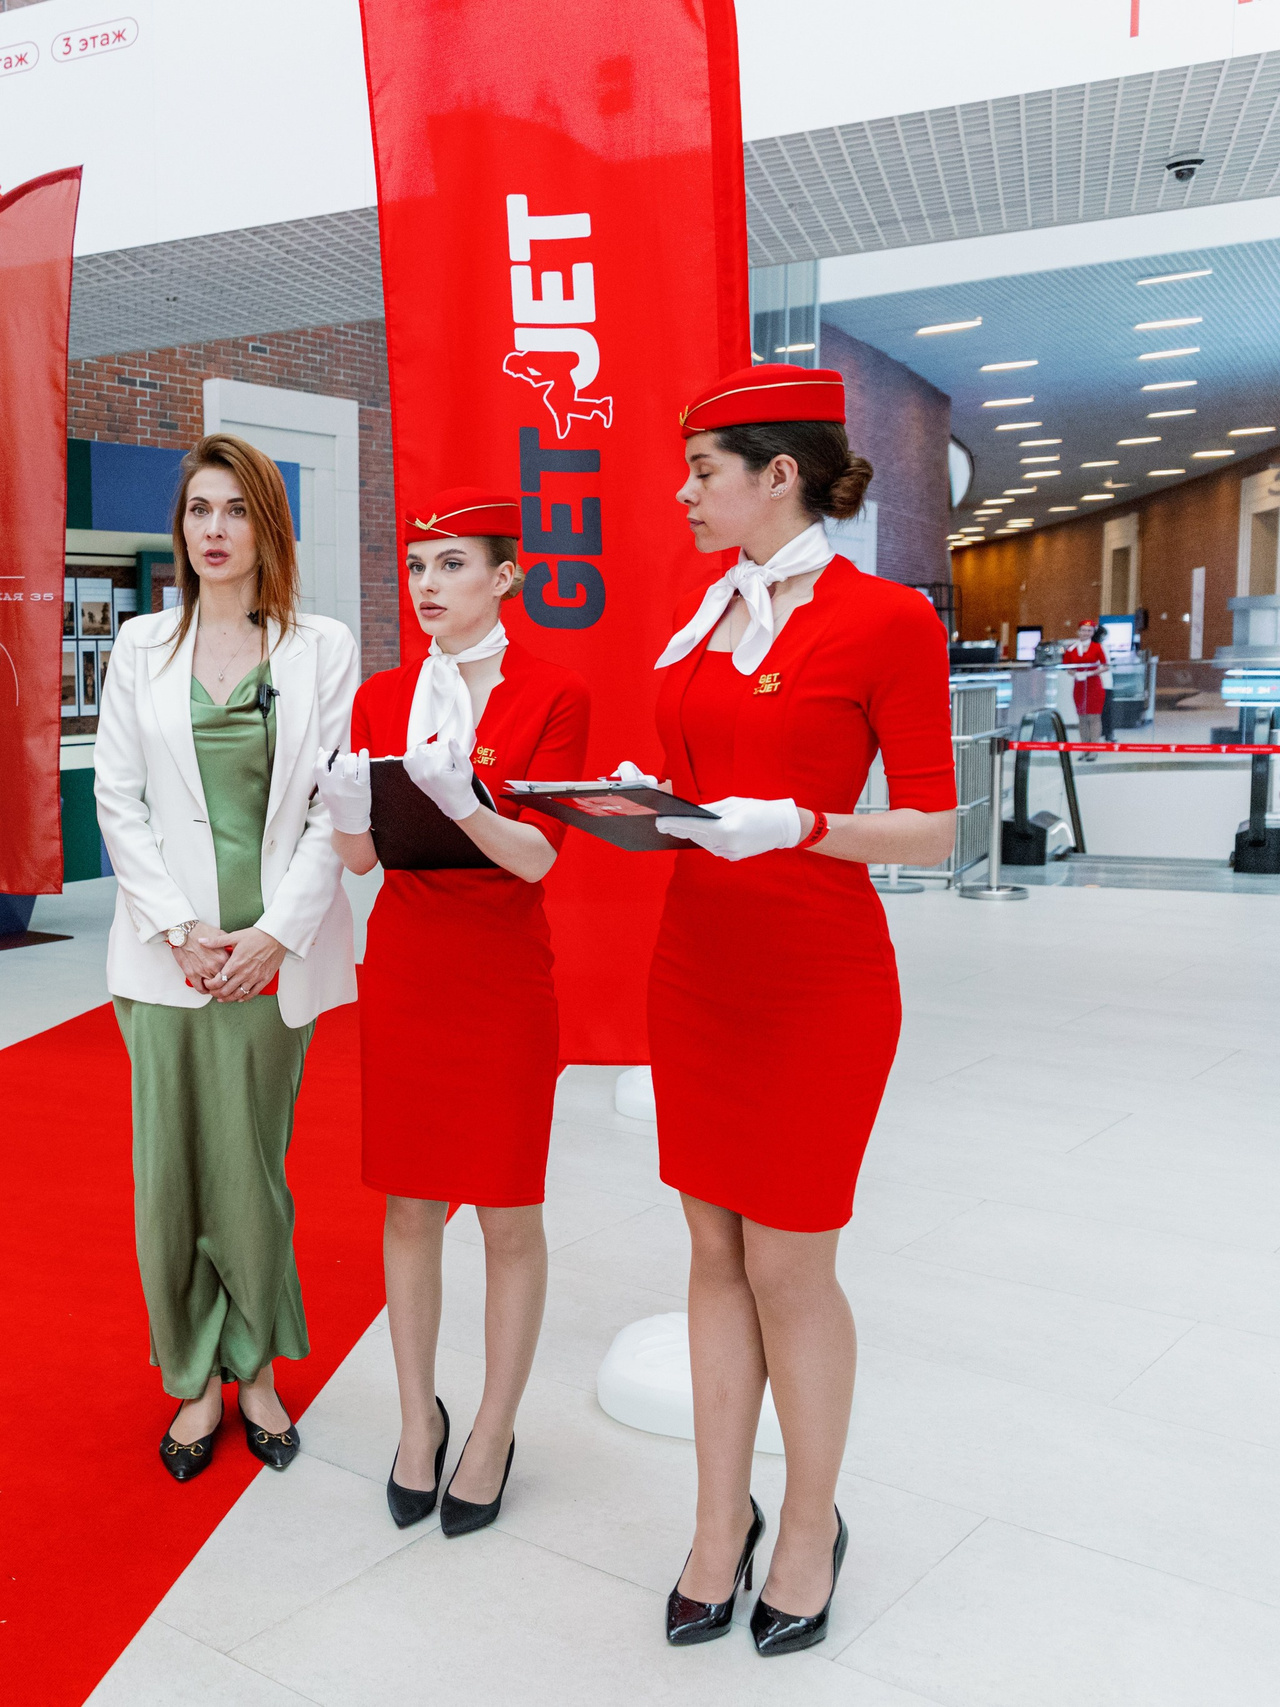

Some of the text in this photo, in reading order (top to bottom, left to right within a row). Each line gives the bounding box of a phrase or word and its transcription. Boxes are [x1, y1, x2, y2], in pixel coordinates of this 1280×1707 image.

[62, 28, 127, 56] 3 этаж
[506, 194, 606, 630] GET JET
[29, 592, 54, 602] 35
[758, 672, 780, 684] GET
[758, 682, 781, 693] JET
[477, 746, 495, 757] GET
[476, 756, 496, 766] JET
